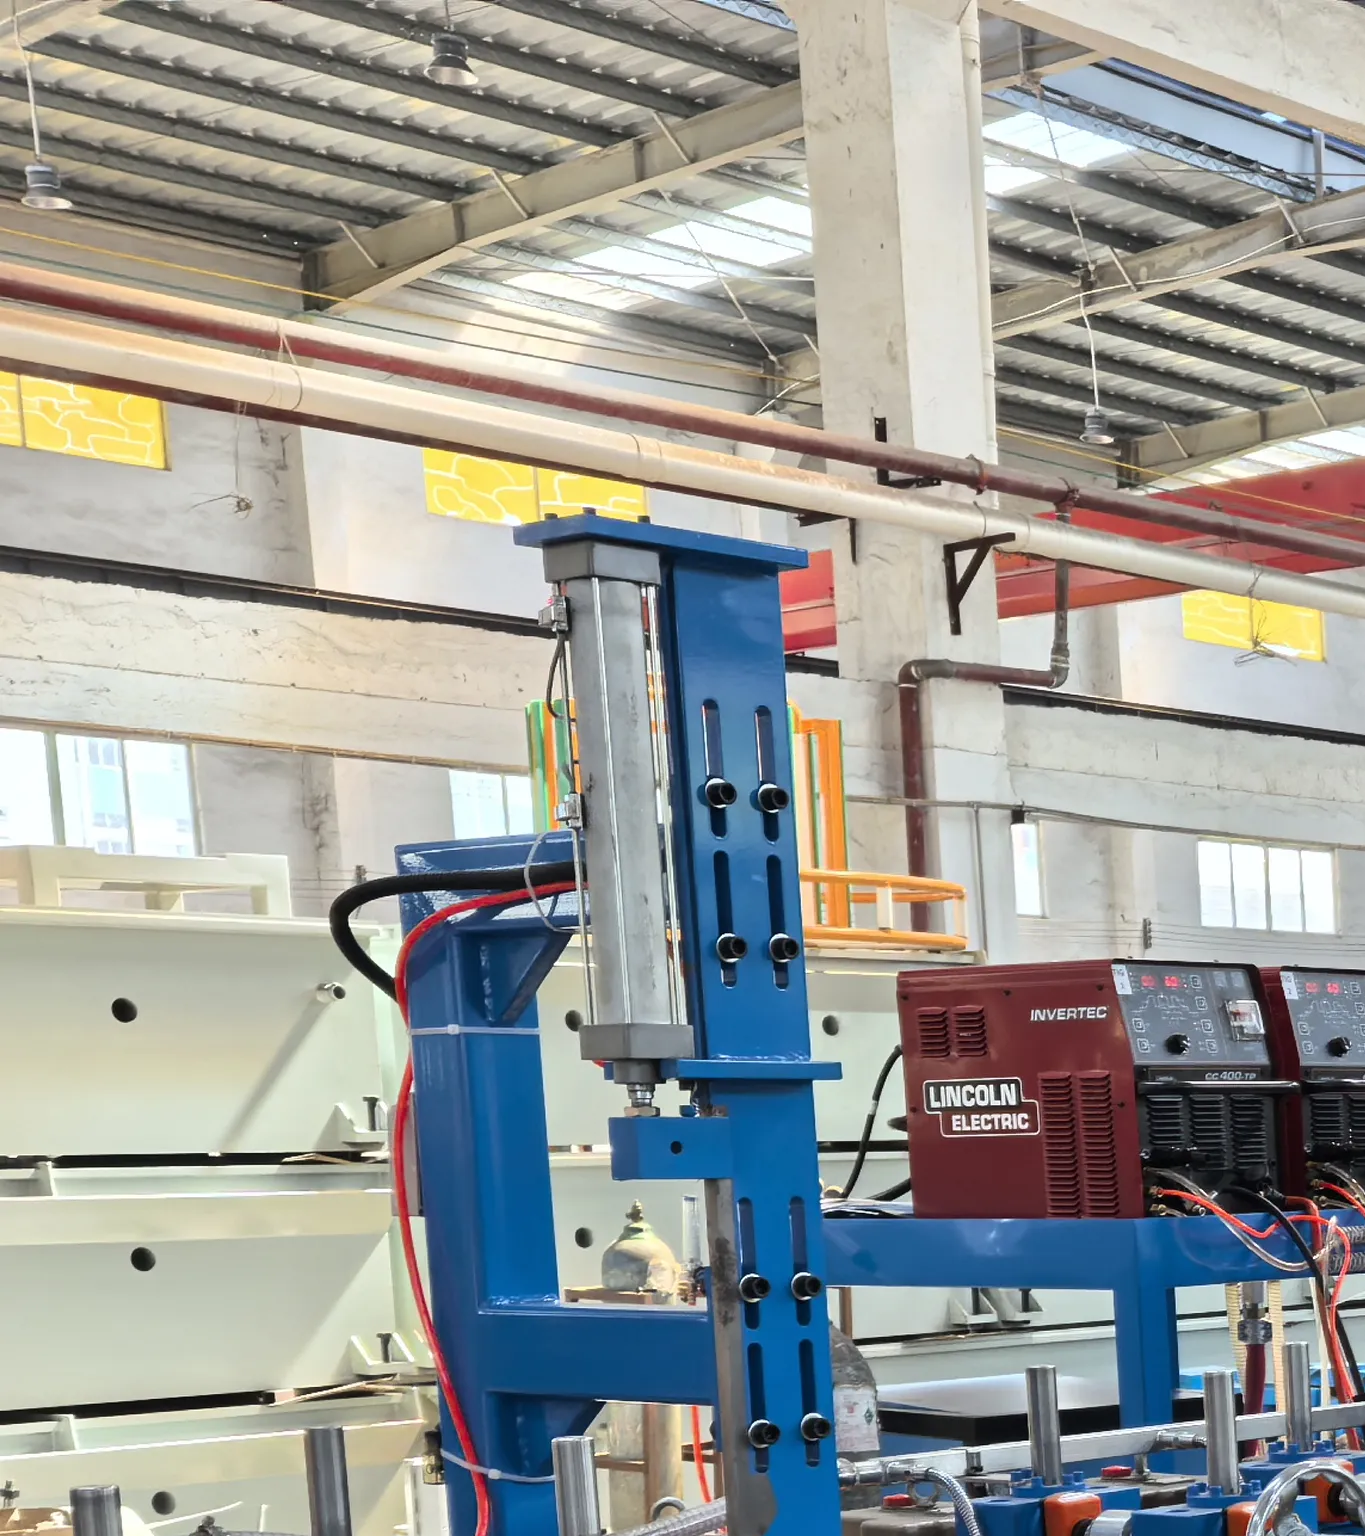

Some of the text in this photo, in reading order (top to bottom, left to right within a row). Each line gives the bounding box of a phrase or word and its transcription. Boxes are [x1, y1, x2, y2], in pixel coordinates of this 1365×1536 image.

[1030, 1005, 1108, 1022] INVERTEC
[928, 1082, 1017, 1109] LINCOLN
[951, 1112, 1030, 1132] ELECTRIC
